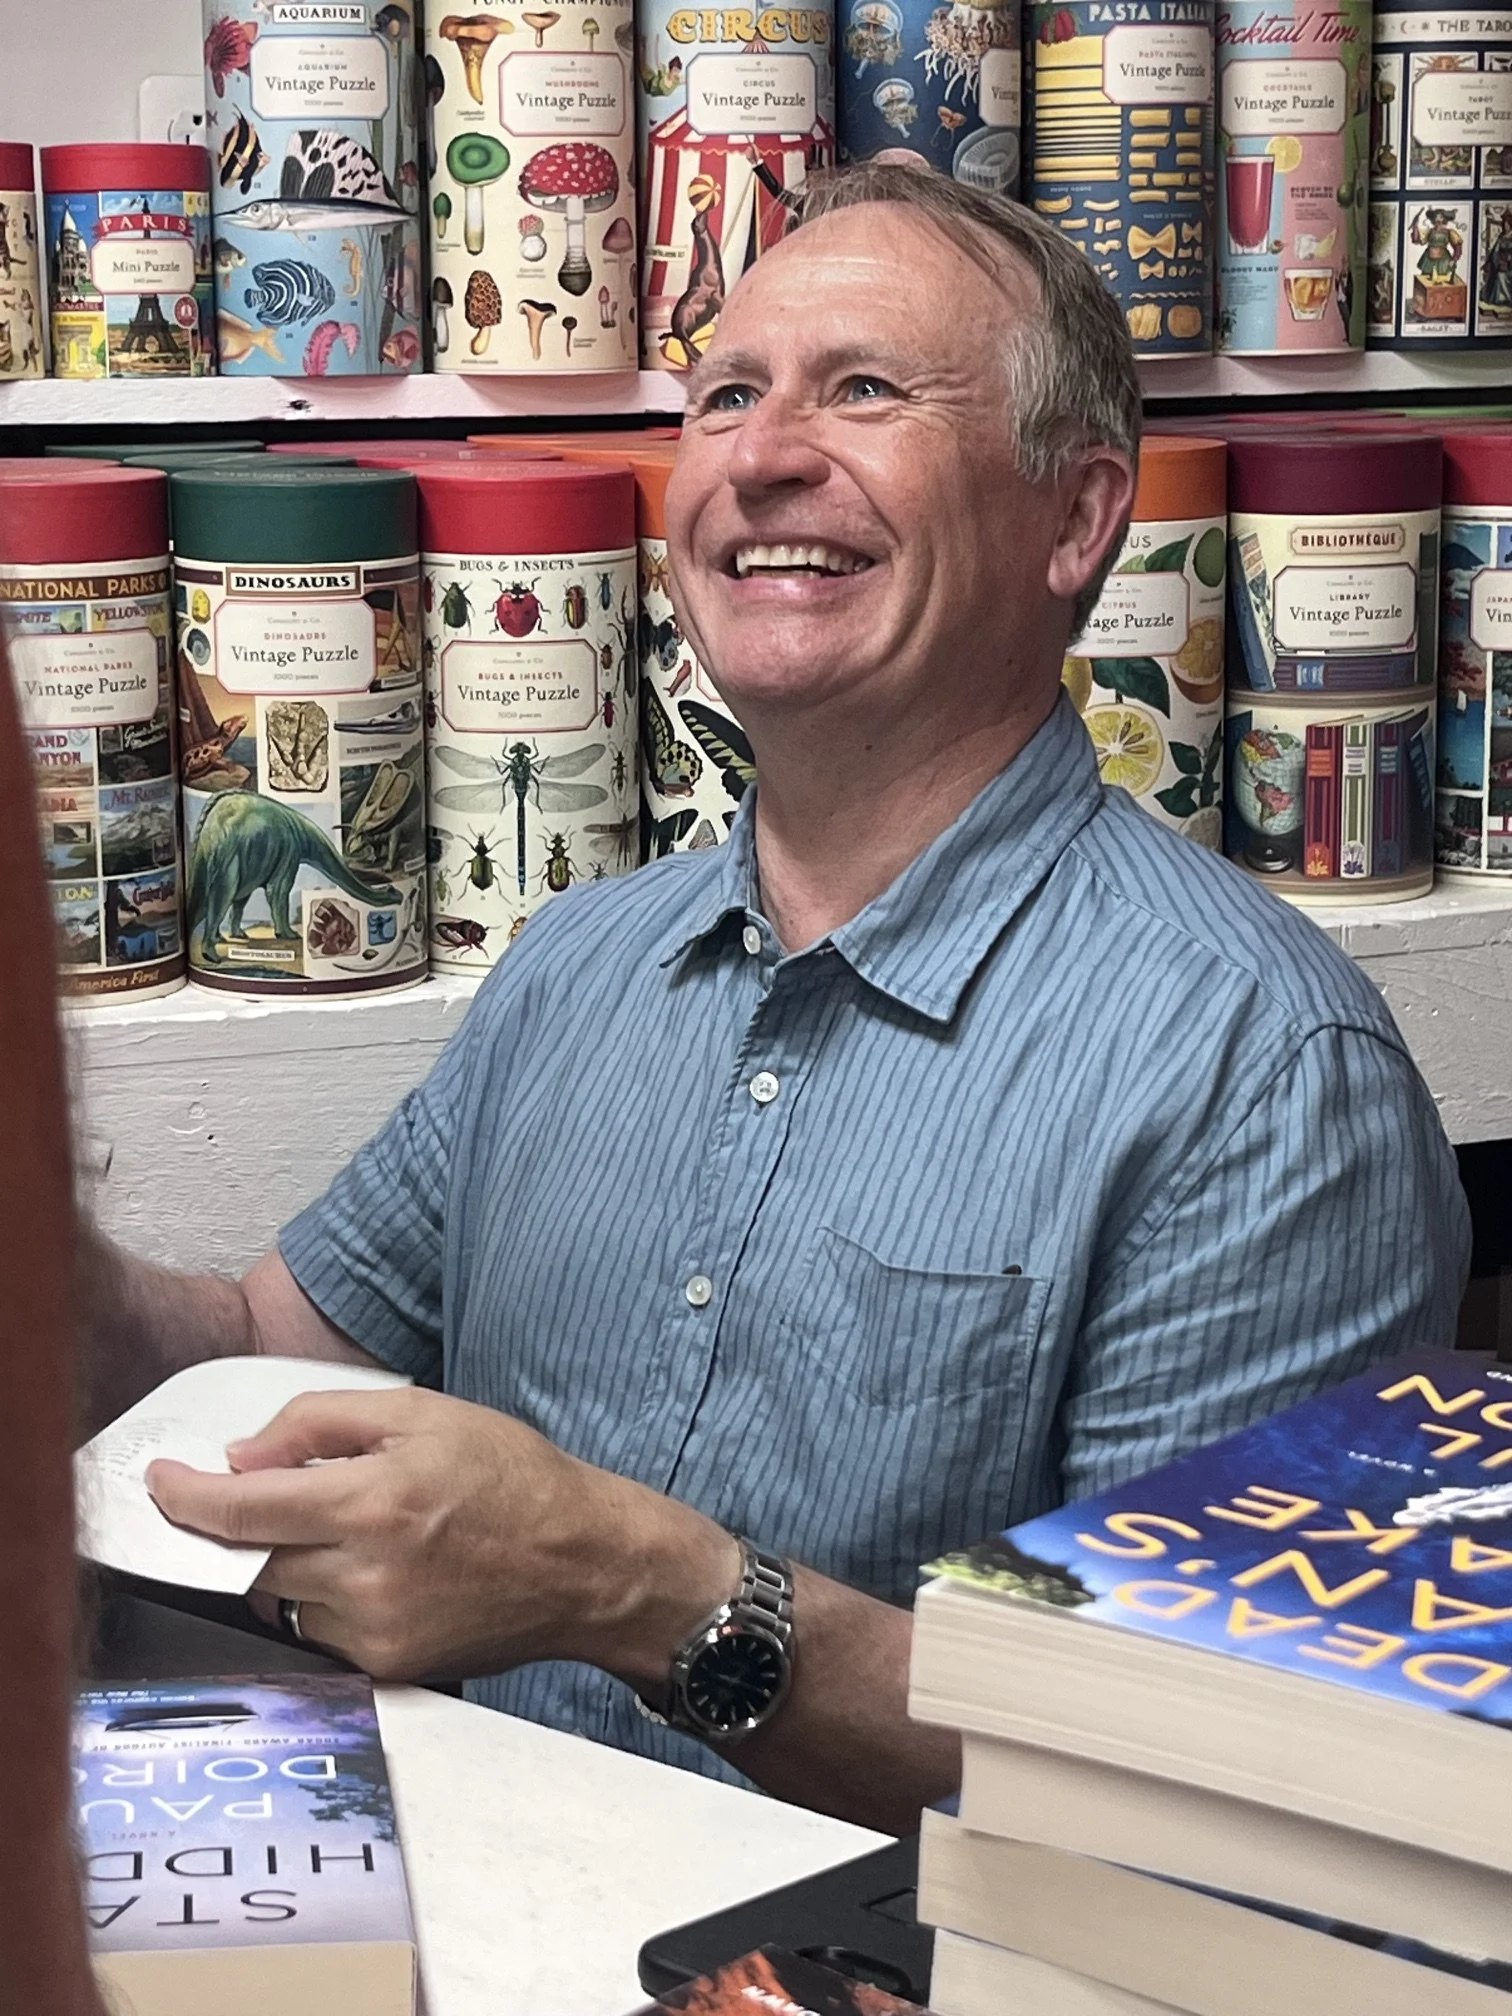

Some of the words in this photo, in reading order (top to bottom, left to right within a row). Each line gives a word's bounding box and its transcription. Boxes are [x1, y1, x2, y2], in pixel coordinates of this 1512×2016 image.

[278, 8, 362, 20] AQUARIUM
[1088, 3, 1151, 22] PASTA
[666, 8, 830, 44] CIRCUS
[1214, 9, 1315, 46] Cocktail
[1313, 12, 1361, 43] Time
[1437, 20, 1471, 33] THE
[1476, 19, 1512, 32] TARO
[298, 63, 348, 71] AQUARIUM
[1120, 63, 1172, 80] Vintage
[1175, 63, 1206, 77] Puzzle
[265, 76, 325, 94] Vintage
[329, 75, 376, 91] Puzzle
[743, 80, 776, 88] CIRCUS
[516, 92, 575, 111] Vintage
[578, 92, 617, 107] Puzzle
[702, 92, 759, 110] Vintage
[764, 92, 806, 107] Puzzle
[1234, 96, 1288, 113] Vintage
[1292, 95, 1336, 109] Puzzle
[1427, 107, 1480, 125] Vintage
[101, 215, 188, 232] PARIS
[113, 261, 141, 273] Mini
[144, 261, 180, 273] Puzzle
[1125, 535, 1152, 549] US
[459, 560, 493, 572] BUGS
[498, 560, 509, 572] &
[515, 559, 575, 572] INSECTS
[0, 581, 99, 599] NATIONAL
[107, 575, 156, 597] PARKS
[234, 575, 351, 589] DINOSAURS
[1329, 593, 1371, 601] LIBRARY
[1124, 612, 1174, 629] Puzzle
[1289, 606, 1350, 625] Vintage
[1354, 605, 1403, 620] Puzzle
[264, 632, 327, 640] DINOSAURS
[231, 645, 297, 666] Vintage
[302, 645, 359, 663] Puzzle
[44, 663, 100, 674] NATIONAL
[478, 672, 505, 680] BUGS
[520, 671, 563, 680] INSECTS
[25, 680, 94, 700] Vintage
[98, 675, 148, 694] Puzzle
[457, 684, 521, 705] Vintage
[526, 684, 580, 701] Puzzle
[34, 736, 68, 748] AND
[40, 751, 82, 766] NYON
[1418, 1421, 1512, 1471] L
[1113, 1579, 1512, 1699] DEAD
[81, 1792, 274, 1825] PAU
[87, 1842, 375, 1882] HIDD
[87, 1890, 298, 1929] STA
